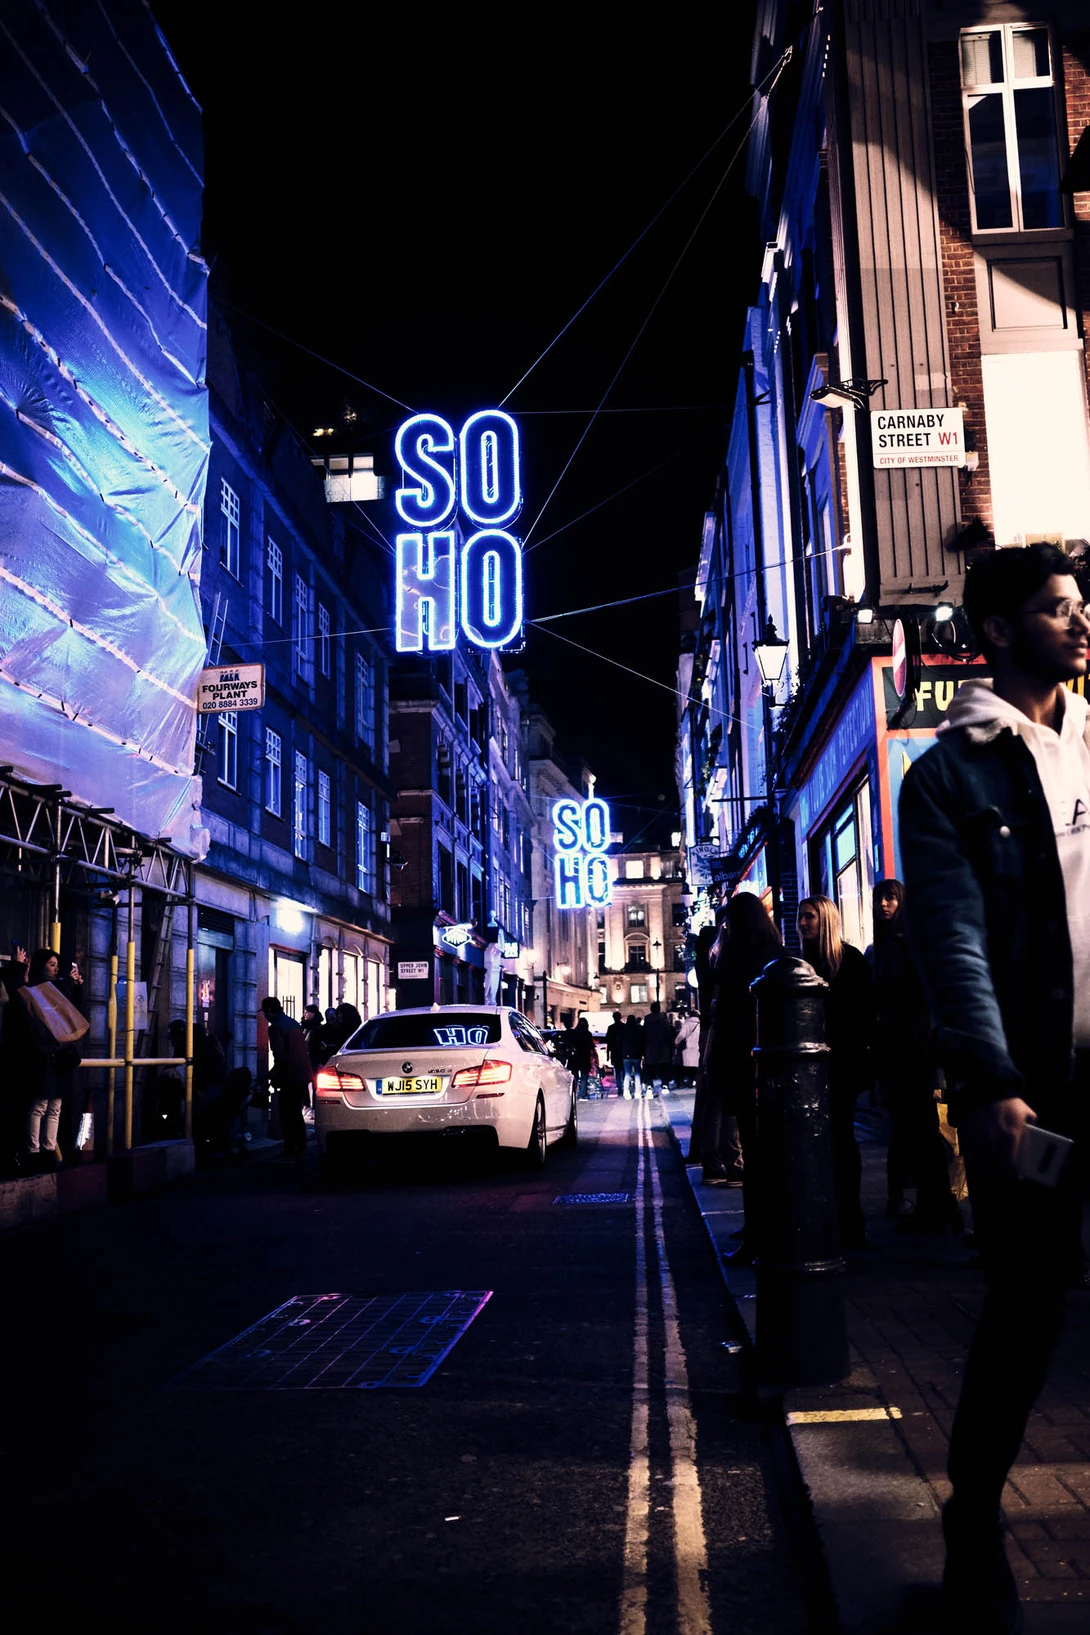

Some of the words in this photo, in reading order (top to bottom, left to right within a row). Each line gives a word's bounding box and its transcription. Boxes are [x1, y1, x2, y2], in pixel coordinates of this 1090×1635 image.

[878, 414, 944, 430] CARNABY
[879, 433, 931, 447] STREET
[938, 432, 958, 445] W1
[908, 455, 959, 463] WESTMINSTER
[202, 680, 258, 693] FOURWAYS
[212, 690, 247, 700] PLANT
[218, 700, 237, 708] 8884
[239, 698, 258, 706] 3339
[415, 1078, 438, 1090] SYH
